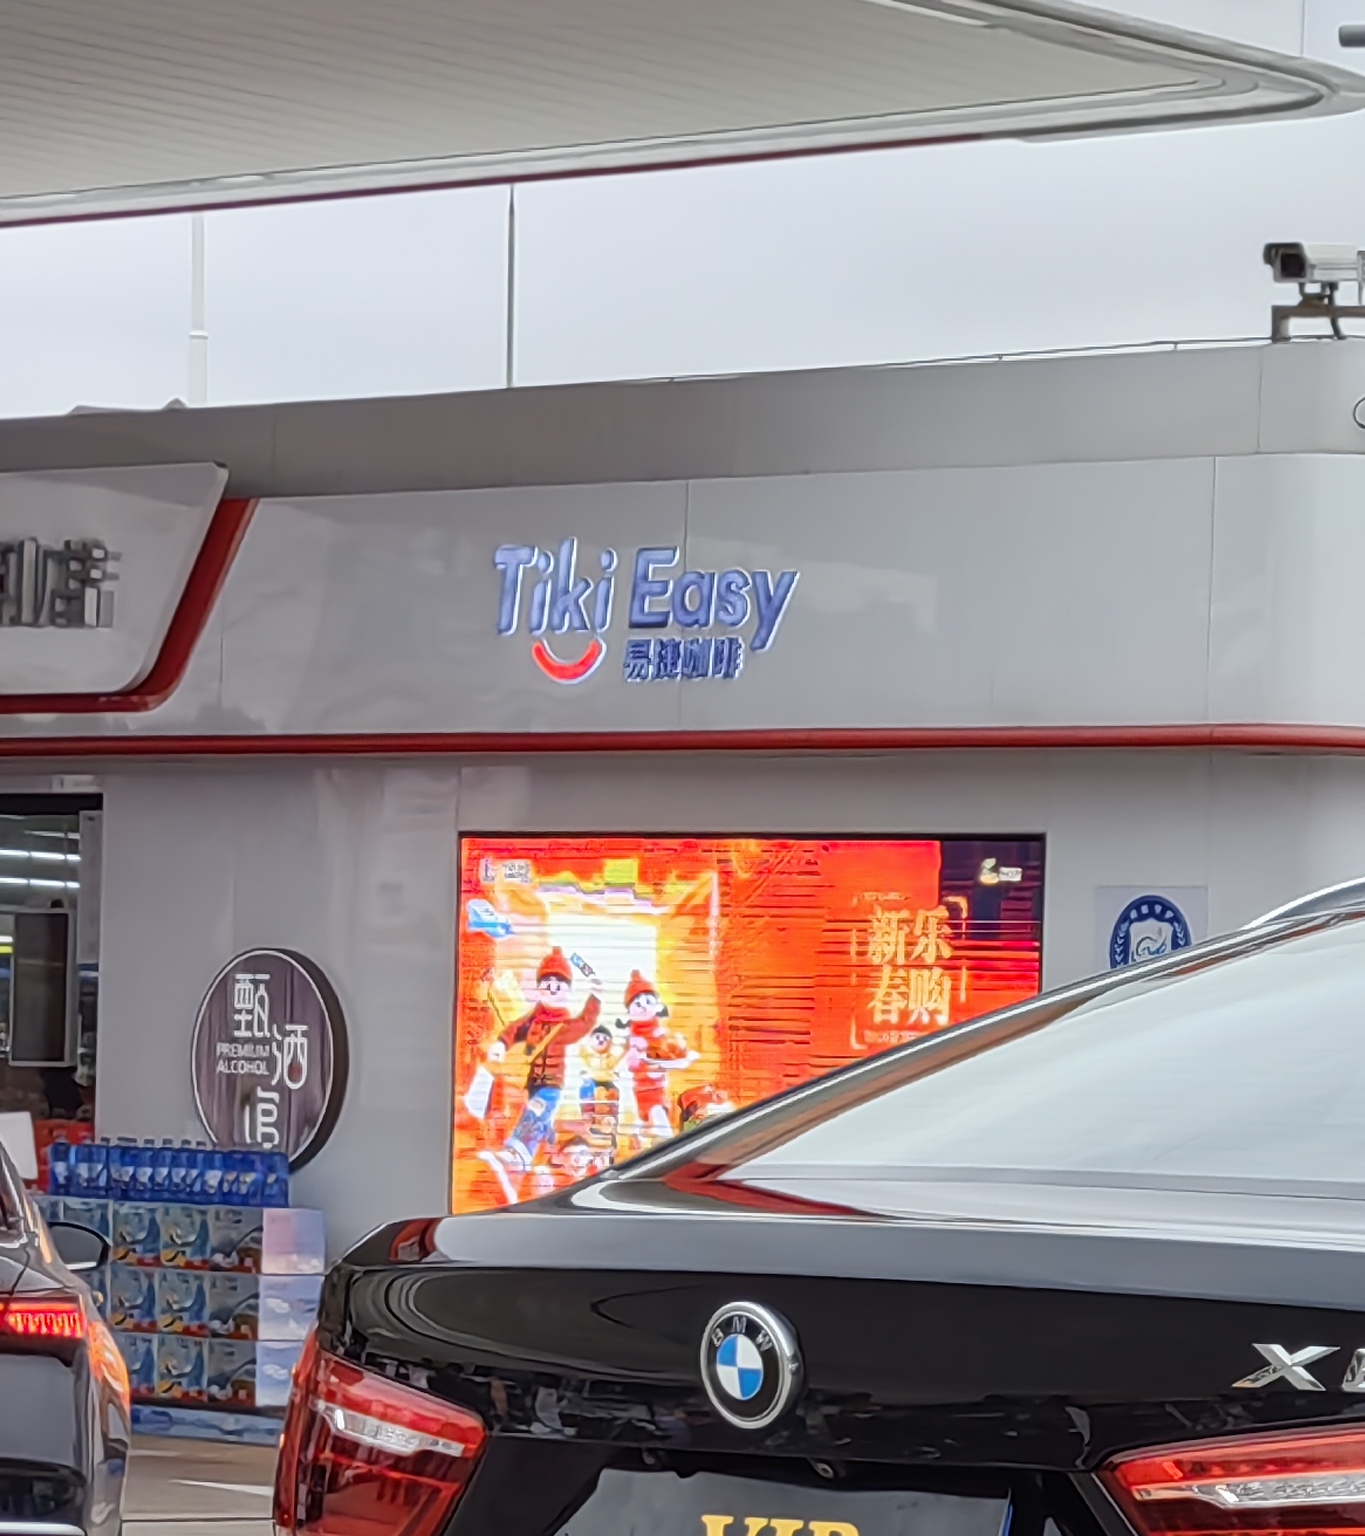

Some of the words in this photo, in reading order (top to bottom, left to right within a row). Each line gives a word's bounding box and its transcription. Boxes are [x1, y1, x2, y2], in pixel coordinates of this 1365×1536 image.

[494, 537, 617, 636] Tiki
[628, 546, 800, 652] Easy
[216, 1042, 270, 1057] PREMIUM
[216, 1060, 270, 1075] ALCOHOL
[712, 1316, 773, 1351] BMW
